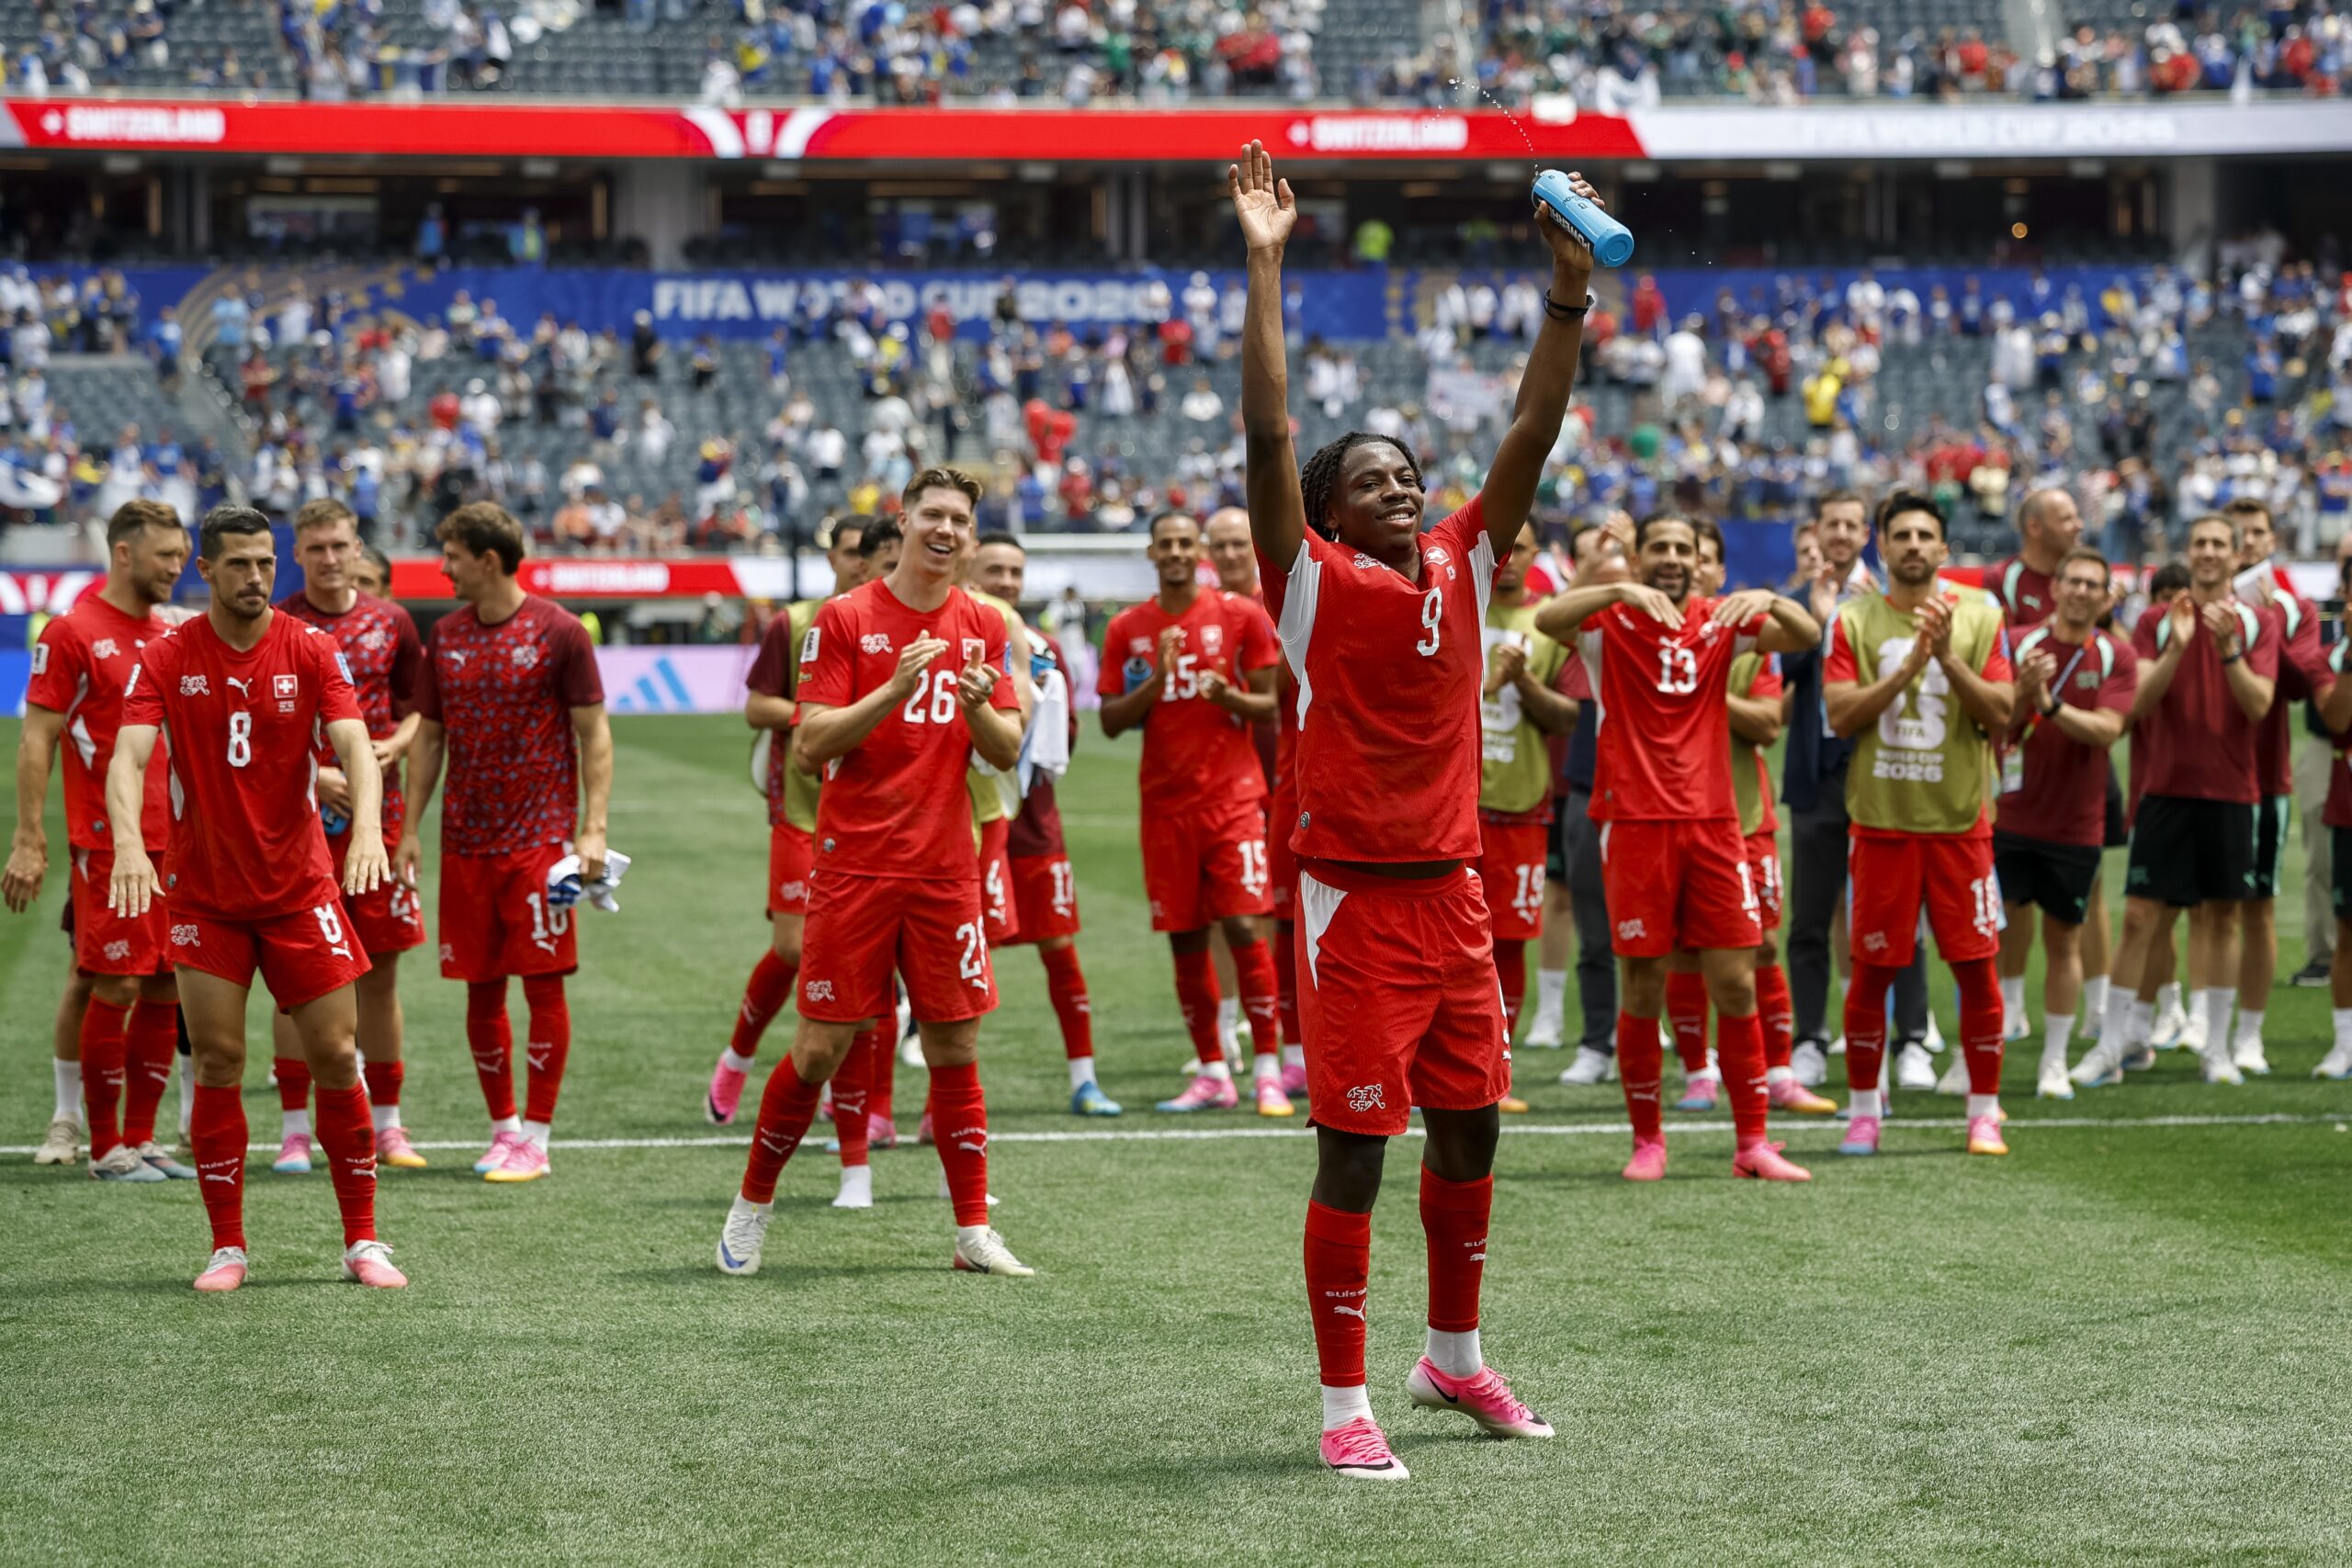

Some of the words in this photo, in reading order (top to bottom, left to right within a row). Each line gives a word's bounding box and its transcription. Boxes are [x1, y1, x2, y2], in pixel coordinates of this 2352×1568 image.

[1544, 202, 1590, 254] POWERA
[653, 280, 753, 321] FIFA
[752, 280, 917, 321] WOD
[1417, 586, 1442, 656] 9
[1161, 653, 1198, 702] 15
[1657, 648, 1697, 694] 13
[904, 669, 957, 724] 26
[227, 711, 253, 768] 8
[1917, 751, 1944, 763] CUP
[1872, 761, 1942, 783] 2026
[1511, 863, 1545, 908] 19
[1464, 1238, 1487, 1247] sui
